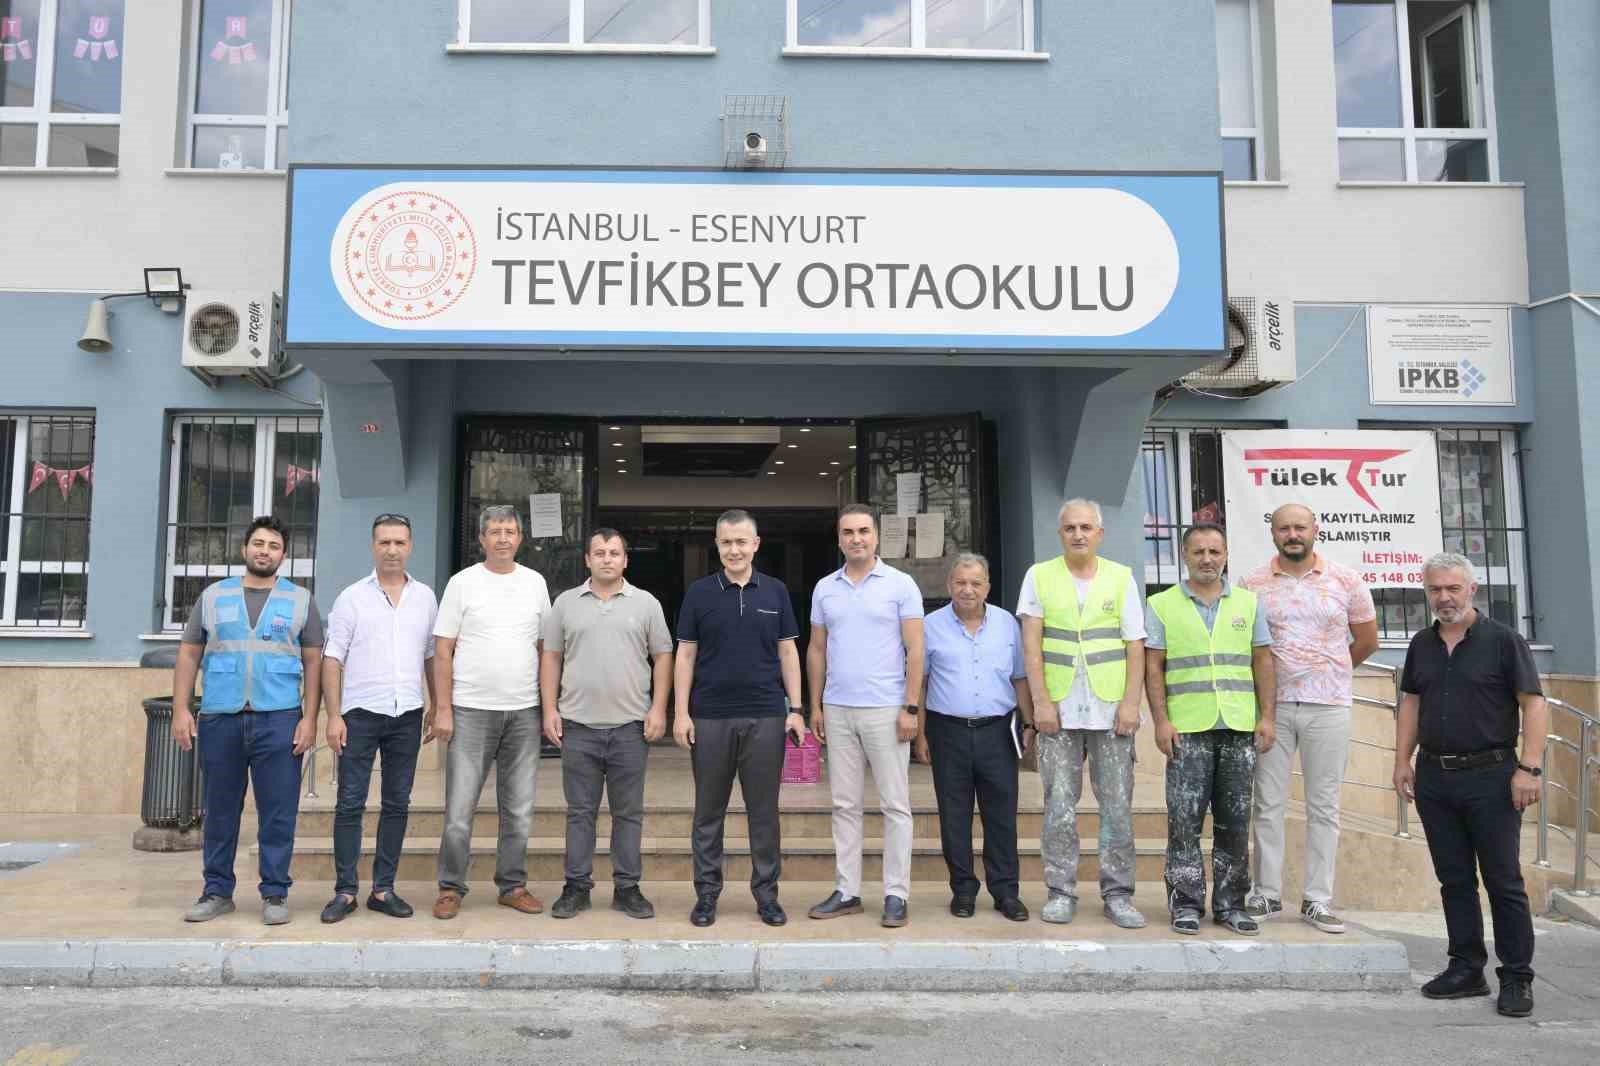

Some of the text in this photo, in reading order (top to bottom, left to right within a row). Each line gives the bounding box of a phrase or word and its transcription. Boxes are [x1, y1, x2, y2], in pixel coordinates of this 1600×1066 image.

[497, 207, 660, 242] İSTANBUL
[692, 214, 866, 244] ESENYURT
[491, 251, 1134, 312] TEVFİKBEY ORTAOKULU
[249, 301, 263, 342] arçelik
[1265, 300, 1284, 351] arçelik
[1398, 367, 1460, 389] IPKB
[1247, 466, 1407, 487] Tülek Tur
[1320, 512, 1416, 524] KAYITLARIMIZ
[1313, 531, 1391, 544] ŞLAMIŞTIR
[1362, 550, 1424, 566] İLETİŞİM:
[1360, 572, 1377, 583] 45
[1382, 572, 1403, 583] 148
